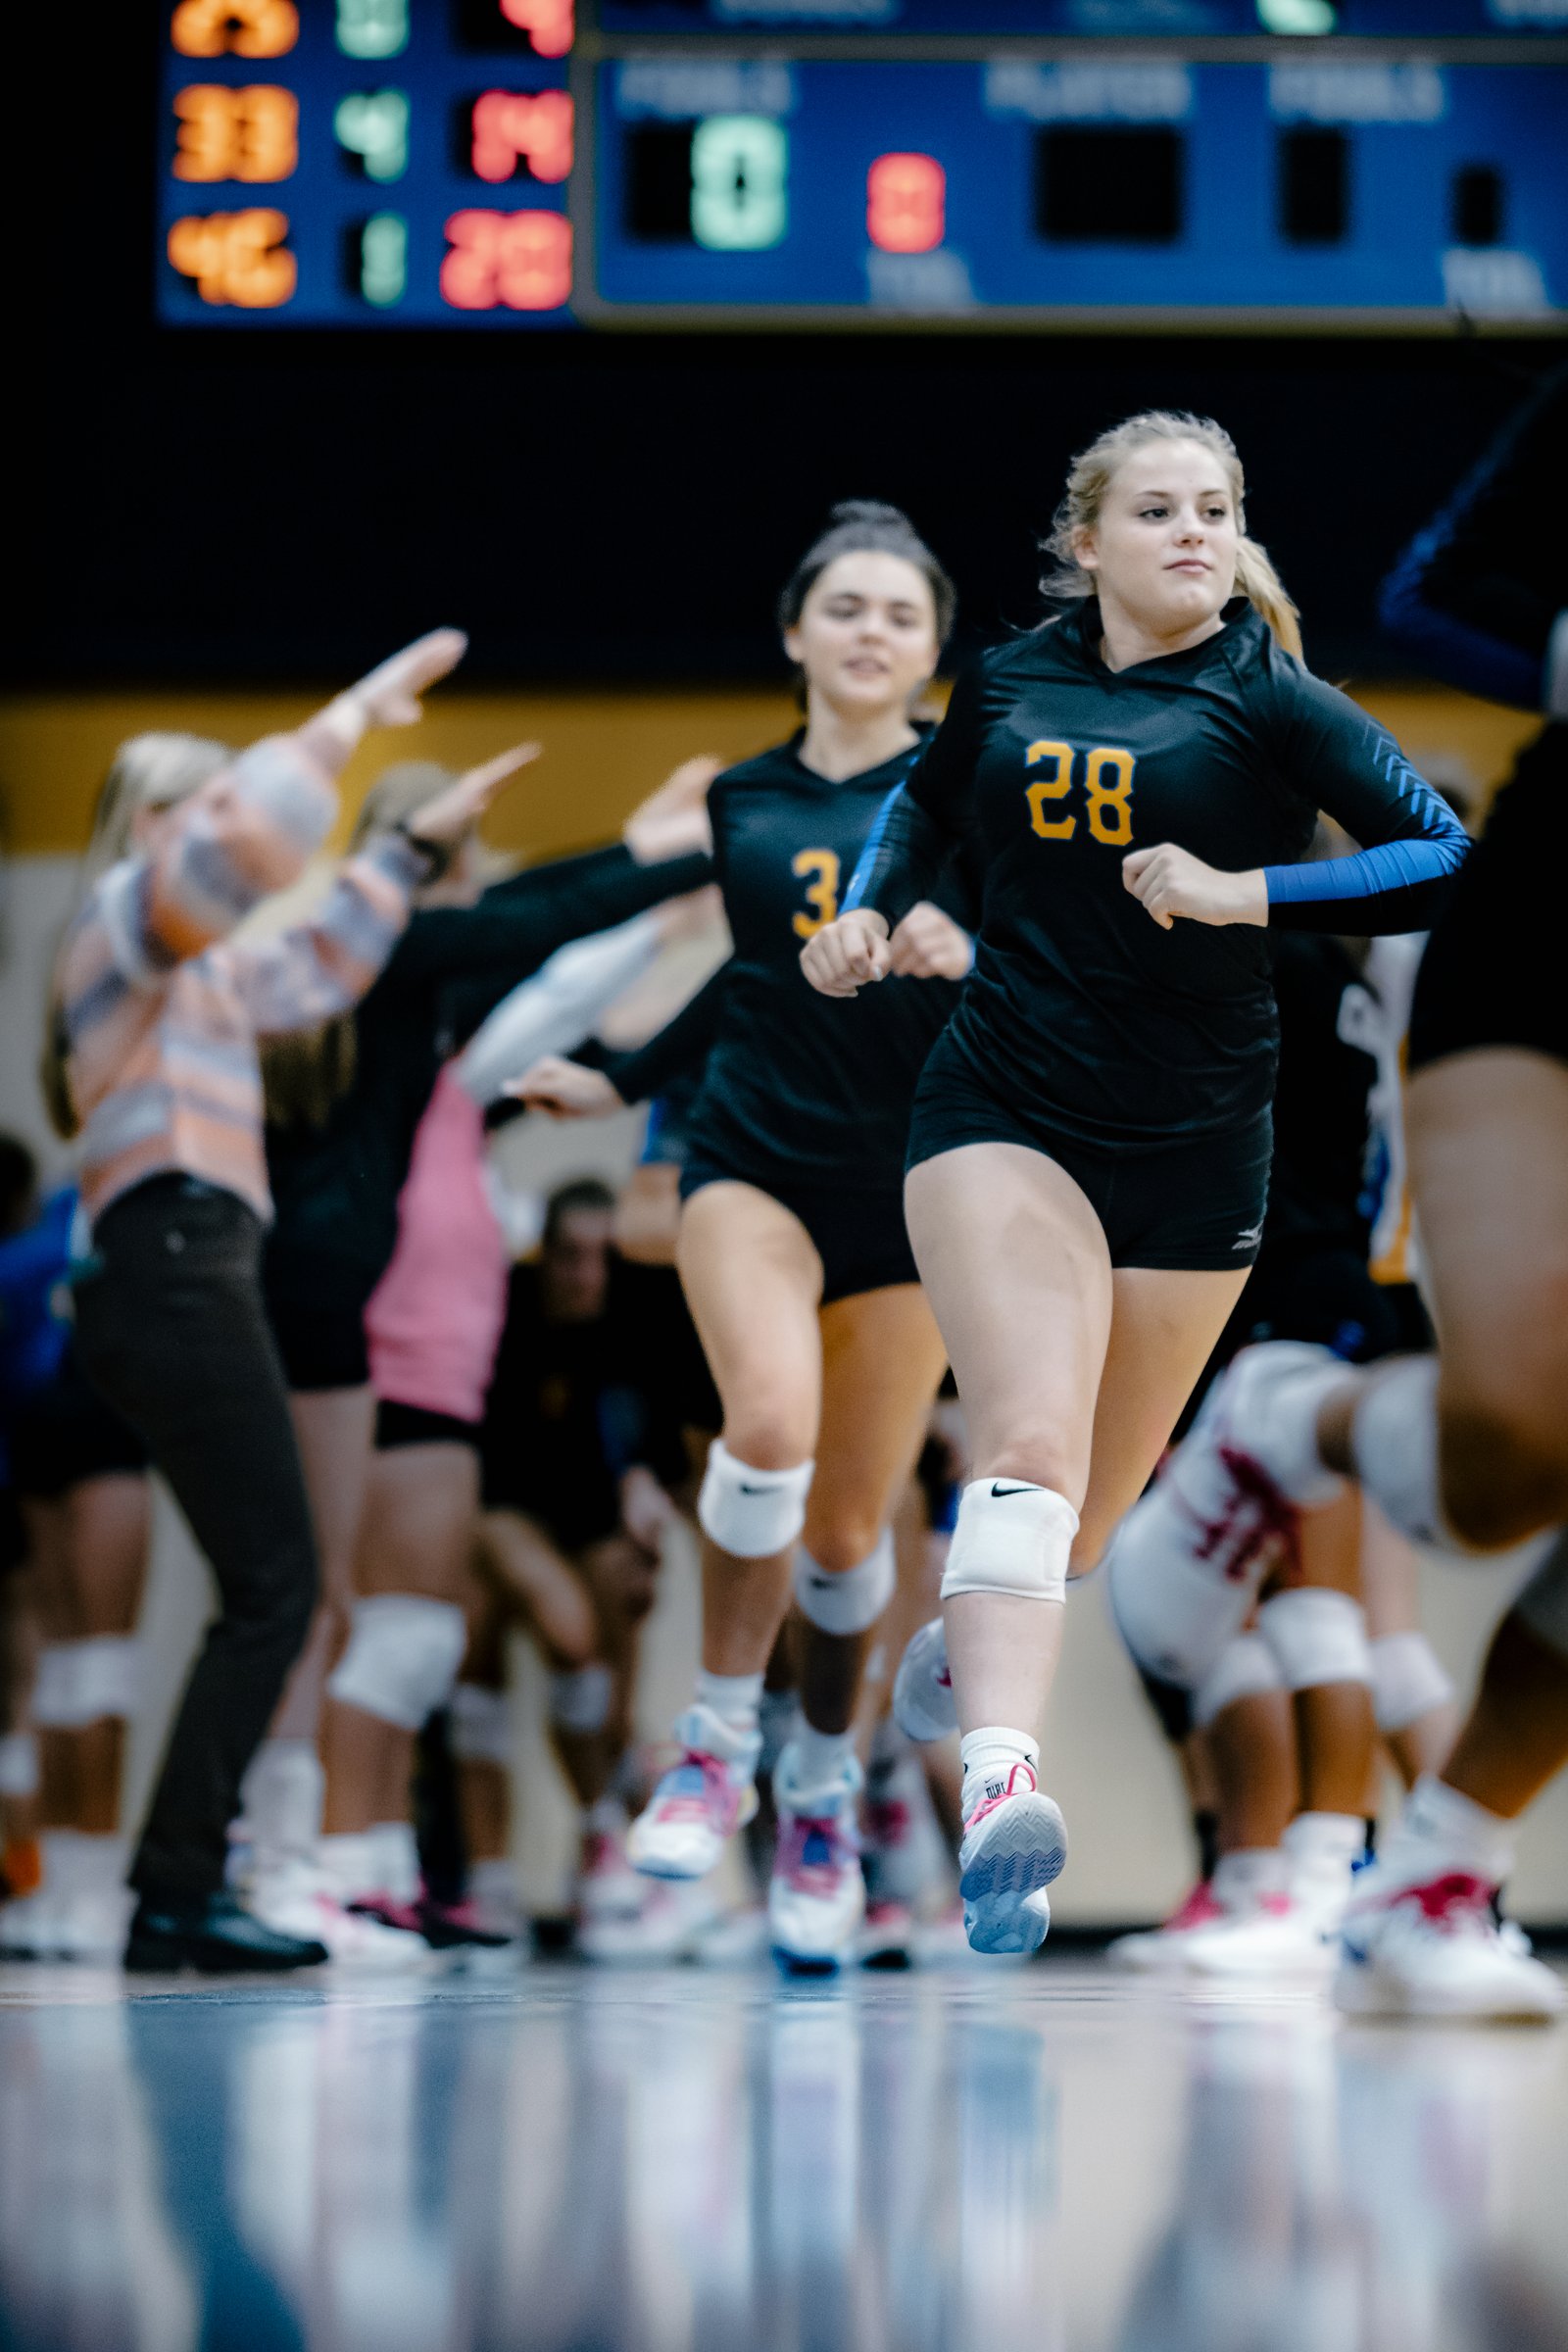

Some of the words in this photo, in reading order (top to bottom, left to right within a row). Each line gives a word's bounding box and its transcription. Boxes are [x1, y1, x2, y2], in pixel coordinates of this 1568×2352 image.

[691, 115, 788, 252] 0
[1025, 740, 1136, 846] 28
[792, 849, 840, 938] 3
